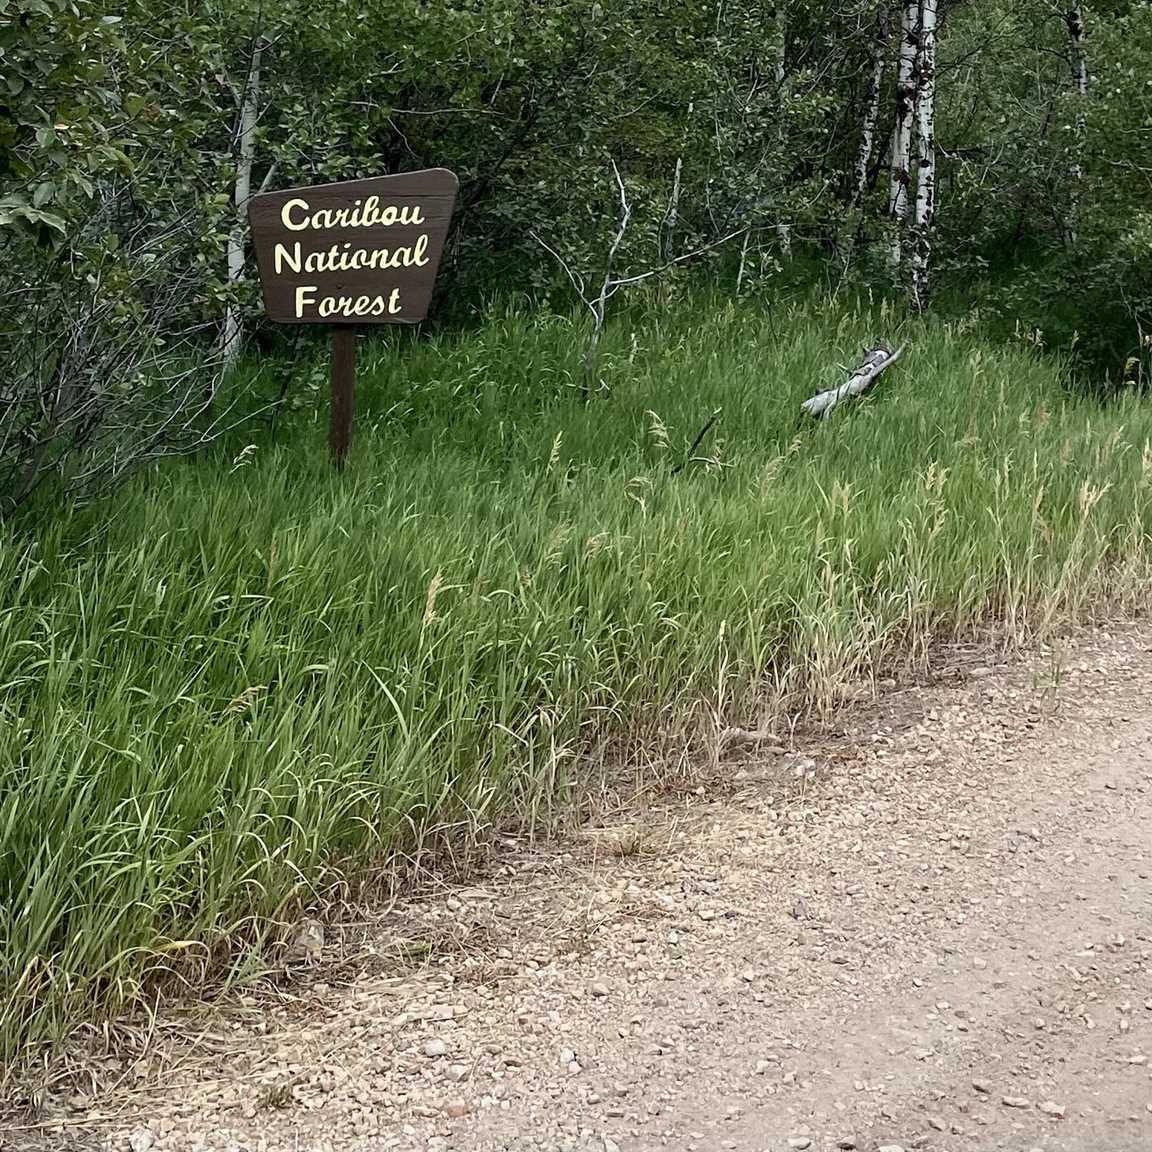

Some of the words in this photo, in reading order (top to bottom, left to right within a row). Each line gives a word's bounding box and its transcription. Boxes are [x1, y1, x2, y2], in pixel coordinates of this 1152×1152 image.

[281, 195, 425, 231] Caribou
[274, 234, 430, 275] National
[295, 285, 402, 318] Forest
